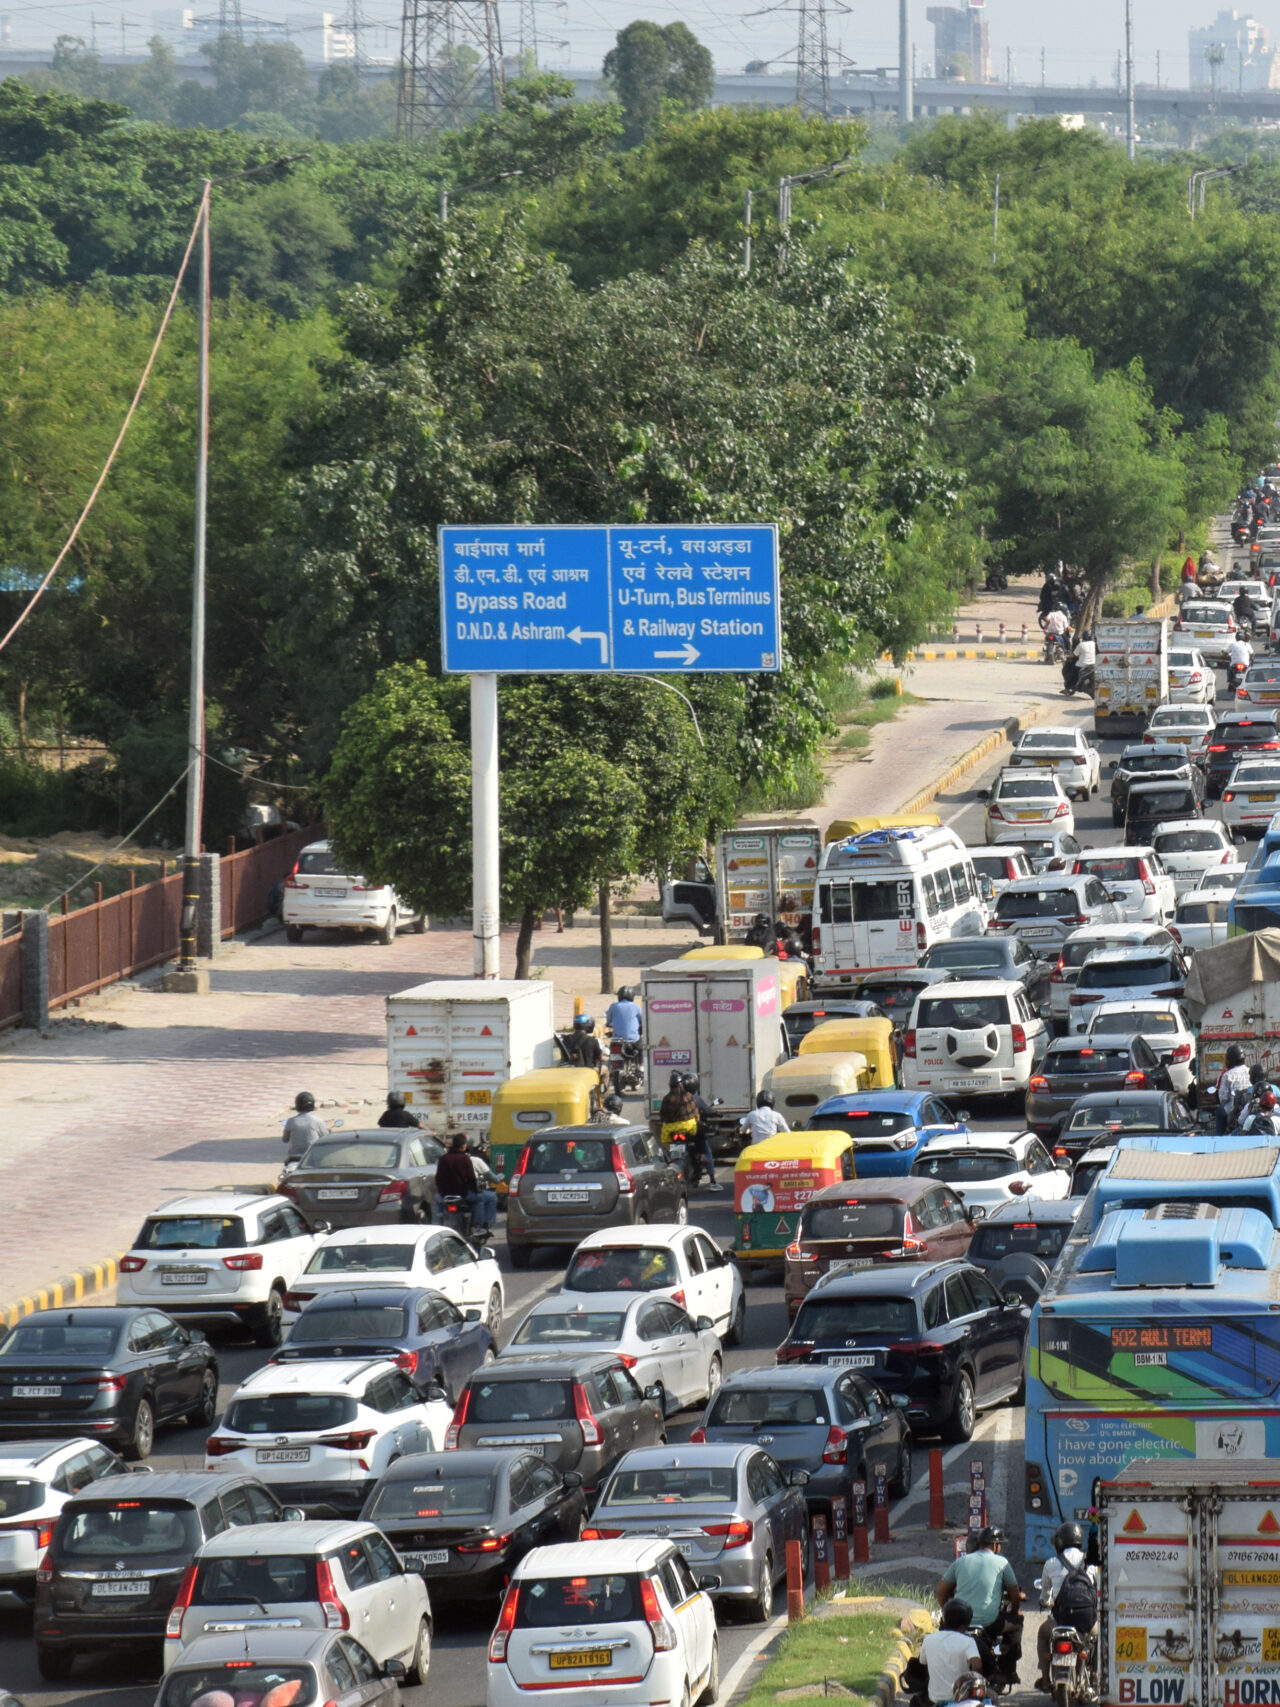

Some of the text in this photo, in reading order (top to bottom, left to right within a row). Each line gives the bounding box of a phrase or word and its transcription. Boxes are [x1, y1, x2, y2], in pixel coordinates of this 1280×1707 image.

[453, 538, 545, 559] बाईपास मार्ग
[528, 564, 546, 586] एवं
[552, 566, 589, 584] आश्रम
[623, 562, 751, 584] एवं रेलवे स्टेशन
[456, 592, 567, 614] Bypass Road
[618, 587, 771, 608] U-Turn, Bus Terminus
[498, 622, 508, 640] &
[511, 621, 566, 640] Ashram
[623, 618, 764, 640] & Railway Station
[924, 1058, 944, 1066] POLICE
[457, 1112, 489, 1121] PLEASE
[1111, 1328, 1137, 1346] 502
[1120, 1422, 1153, 1430] ELECTRIC
[1058, 1438, 1184, 1453] i have gone electric.
[1058, 1454, 1086, 1465] how
[1089, 1454, 1127, 1465] about
[877, 1476, 885, 1504] PWD
[856, 1494, 864, 1524] PWD
[836, 1510, 845, 1539] PWD
[816, 1530, 826, 1559] PWD
[1116, 1642, 1134, 1658] 40
[1119, 1678, 1185, 1704] BLOW
